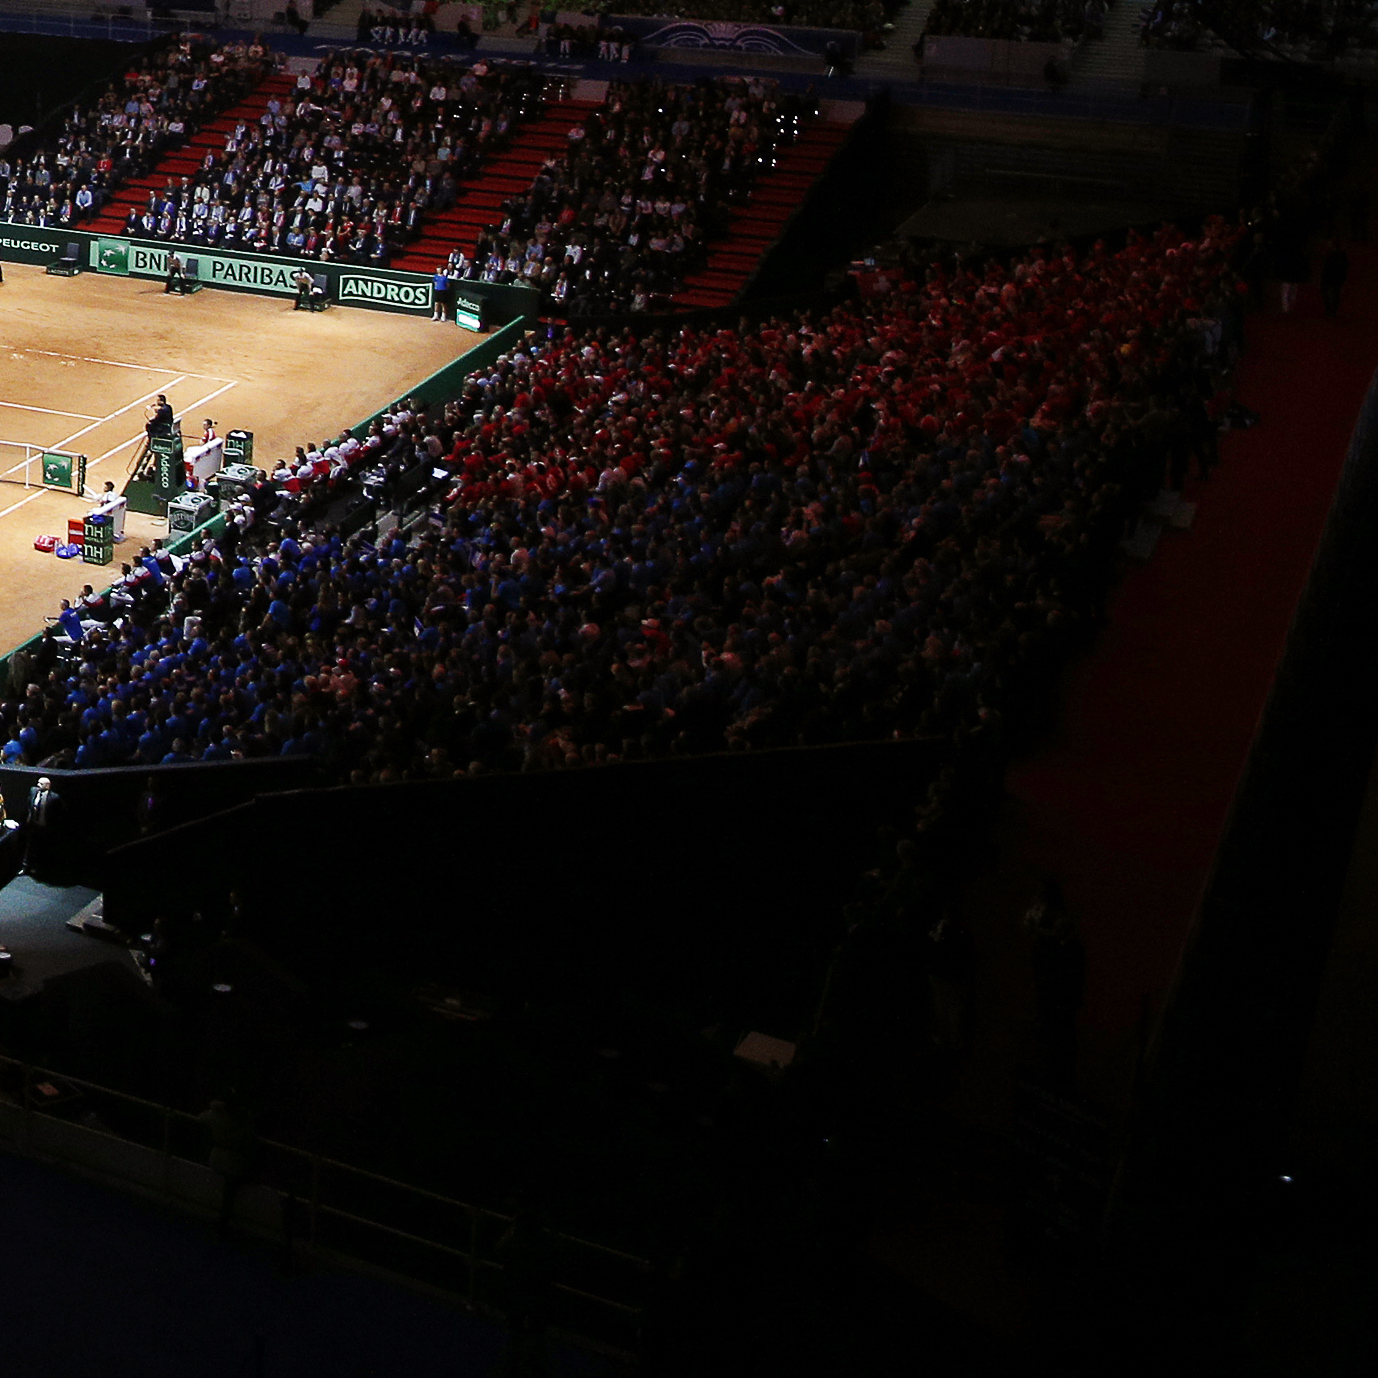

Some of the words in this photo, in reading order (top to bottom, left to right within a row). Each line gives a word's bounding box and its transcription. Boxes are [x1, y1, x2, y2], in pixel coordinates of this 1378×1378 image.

[135, 250, 168, 272] BN
[344, 279, 427, 305] ANDROS
[457, 297, 481, 312] Adecco
[160, 453, 170, 488] Adecco
